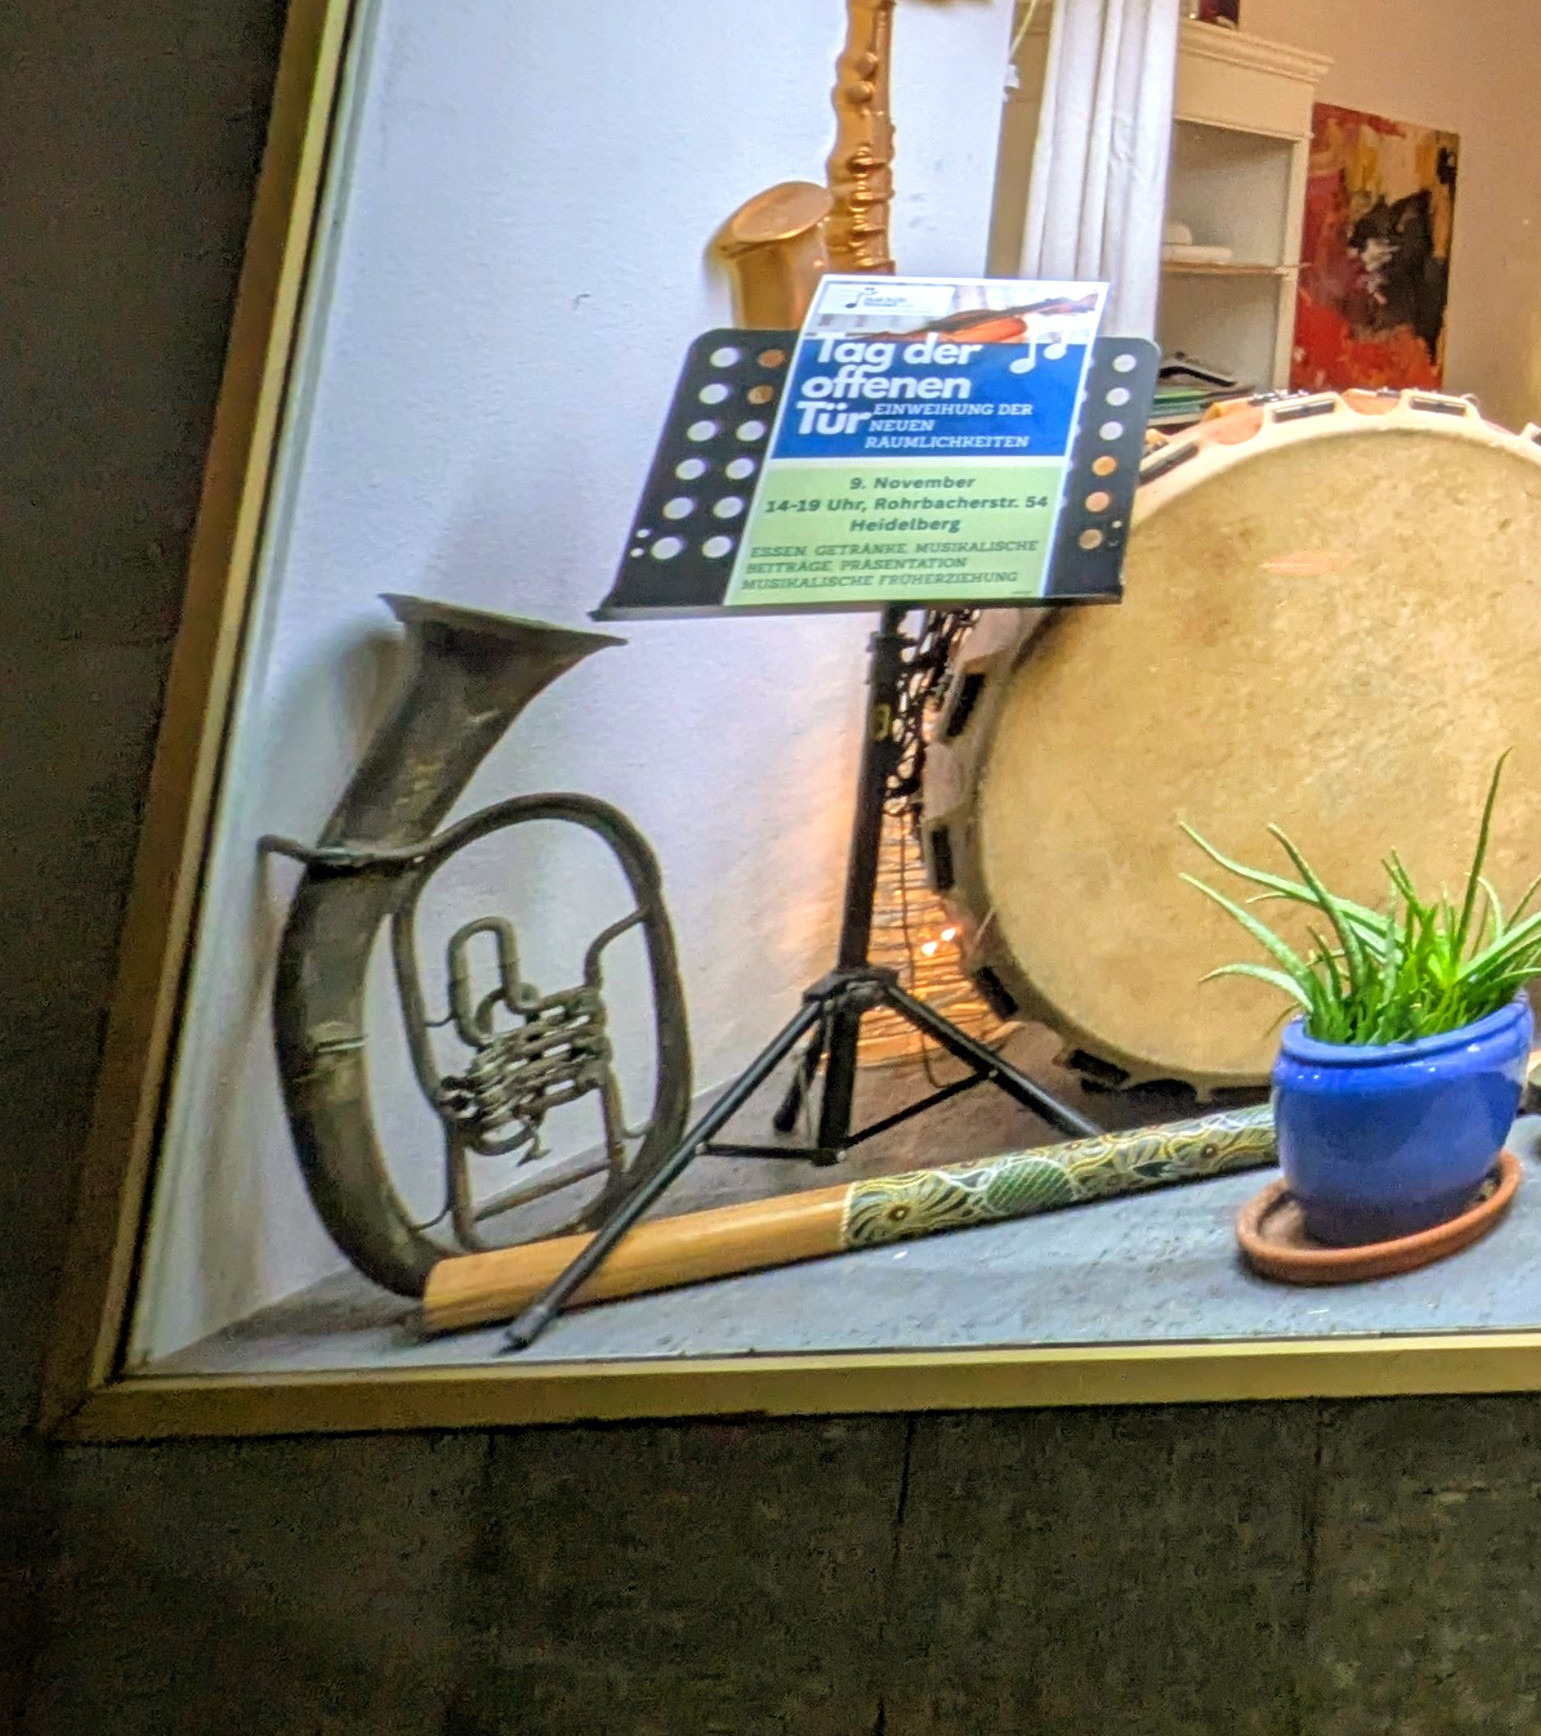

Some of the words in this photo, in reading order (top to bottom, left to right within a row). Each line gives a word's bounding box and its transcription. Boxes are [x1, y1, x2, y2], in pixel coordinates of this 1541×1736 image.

[815, 332, 896, 373] Tag
[902, 331, 984, 365] der
[801, 364, 972, 399] offenen
[796, 400, 872, 435] Tür
[873, 403, 994, 416] EINWEIHUNG
[997, 403, 1034, 416] DER
[868, 419, 935, 432] NEUEN
[850, 477, 867, 490] 9.
[874, 476, 977, 490] November
[765, 499, 821, 513] 14-19
[827, 498, 867, 512] Uhr,
[874, 495, 1019, 511] Rohrbacherstr.
[1025, 495, 1048, 508] 54
[850, 518, 962, 533] Heidelberg
